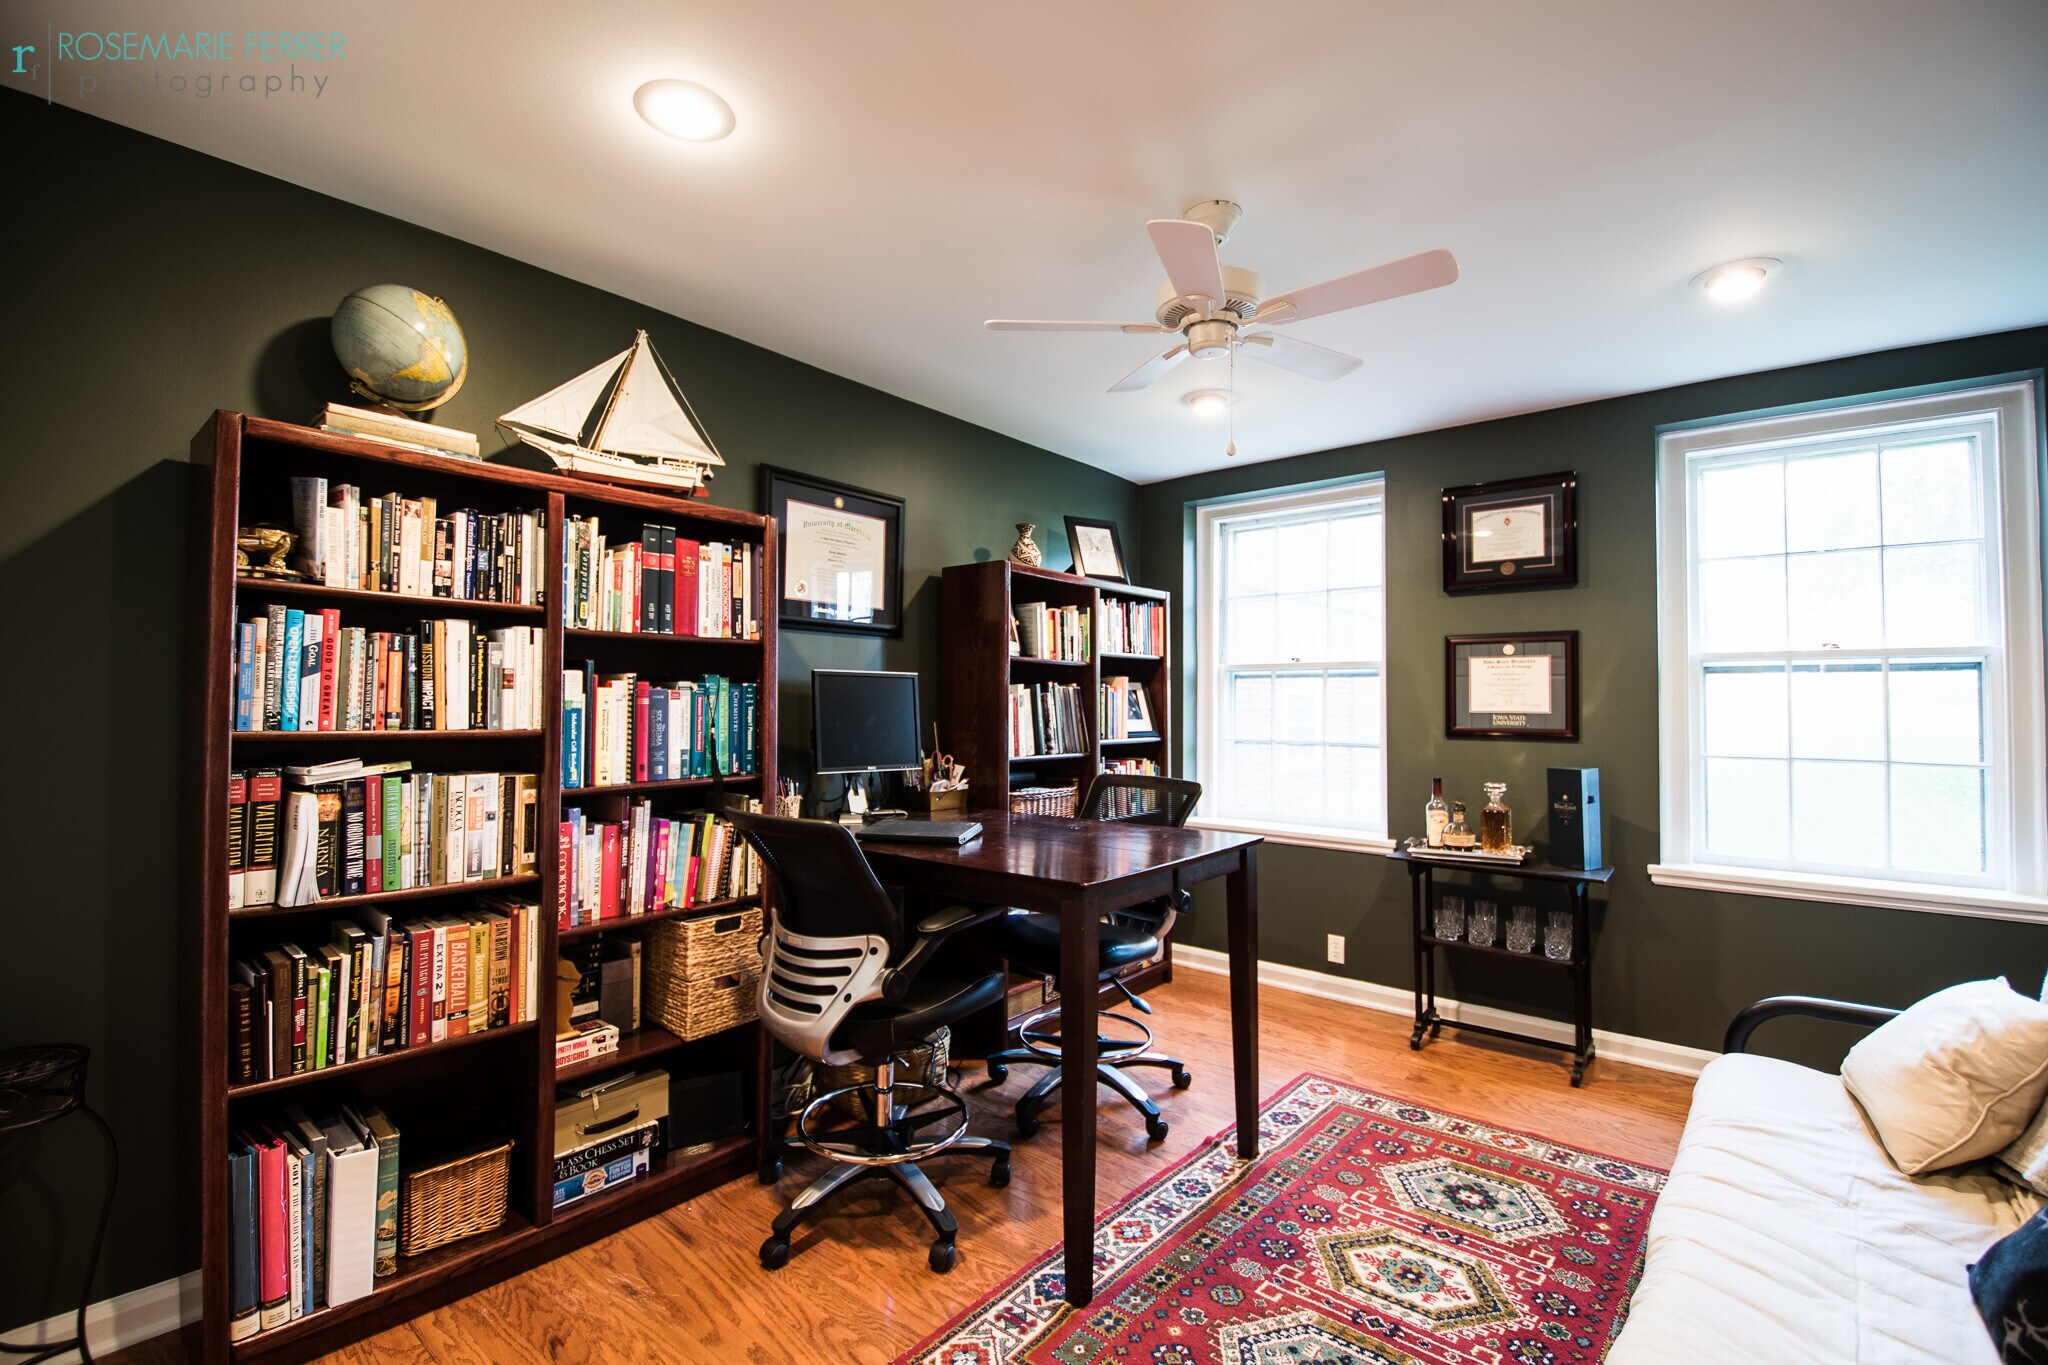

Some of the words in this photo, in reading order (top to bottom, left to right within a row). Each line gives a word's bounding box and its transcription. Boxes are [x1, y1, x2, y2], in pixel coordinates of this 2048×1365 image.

[478, 552, 487, 568] Salt
[580, 550, 589, 599] Vorsprung
[288, 626, 299, 654] OPEN
[308, 645, 318, 667] GOAL
[422, 643, 432, 680] MISSION
[286, 655, 298, 714] LEADERSHIP
[325, 669, 332, 680] TO
[323, 685, 331, 716] GREAT
[422, 680, 433, 710] IMPACT
[388, 785, 398, 802] DICK
[347, 812, 363, 822] NO
[387, 804, 398, 831] FRANCIS
[455, 791, 463, 831] IACOCCA
[229, 807, 243, 866] VALUATION
[254, 804, 275, 862] VALUATION
[347, 823, 363, 859] ORDINARY
[317, 828, 329, 877] NARNIA
[388, 839, 396, 855] UNDER
[346, 860, 363, 879] TIME
[388, 856, 396, 876] ORDERS
[558, 851, 567, 915] COOKBOOK
[496, 922, 508, 936] DAN
[419, 938, 429, 950] THE
[495, 938, 508, 961] BROWN
[354, 951, 362, 976] Scientific
[418, 953, 428, 986] PENTAGON
[451, 942, 467, 1009] BASKETBALL
[351, 977, 361, 1000] Integrity
[475, 953, 485, 1000] TOASTMASTER
[555, 1055, 570, 1065] BOYS
[572, 1050, 589, 1060] GIRLS
[557, 1045, 571, 1054] PRETTY
[573, 1040, 587, 1049] WOMAN
[554, 1155, 583, 1172] GLASS
[585, 1142, 617, 1160] CHESS
[619, 1135, 635, 1148] SET
[559, 1171, 567, 1179] &
[570, 1159, 598, 1176] BOOK
[609, 1169, 632, 1180] EVERYONE
[621, 1163, 631, 1172] FOR
[292, 1194, 300, 1210] THE
[292, 1211, 300, 1242] GOLDEN
[292, 1244, 300, 1269] YEARS
